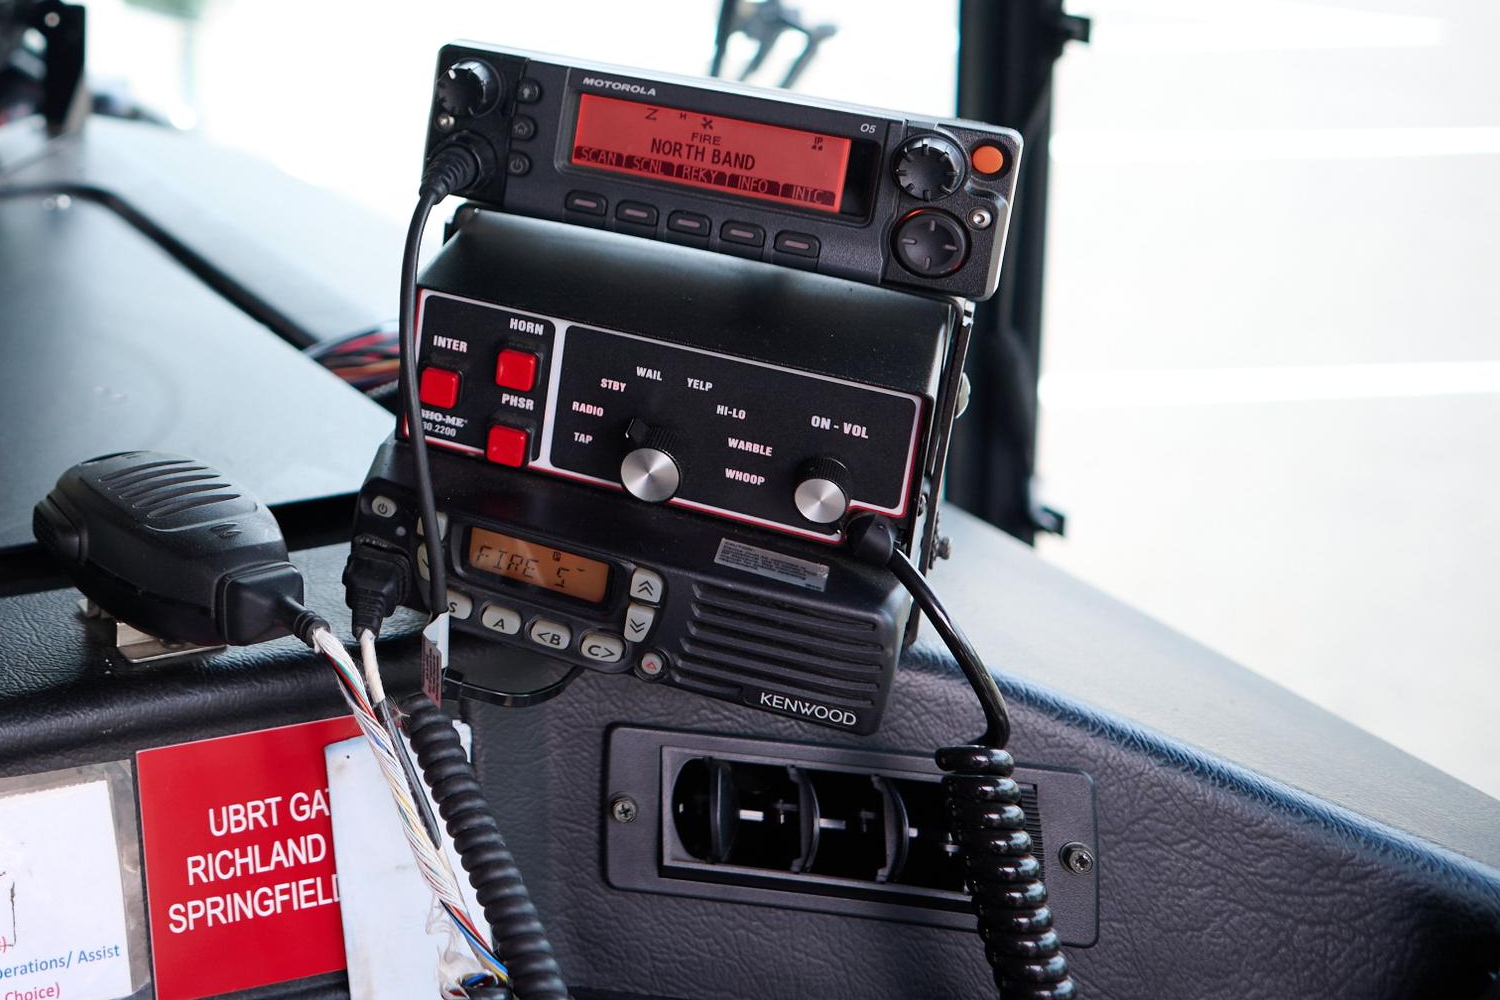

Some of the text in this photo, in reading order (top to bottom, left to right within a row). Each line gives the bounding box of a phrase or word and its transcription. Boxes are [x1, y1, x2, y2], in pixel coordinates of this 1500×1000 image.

[583, 77, 656, 96] MOTOROLA
[691, 132, 722, 146] FIRE
[651, 137, 756, 171] NORTH BAND
[581, 147, 617, 165] SCAN
[683, 167, 718, 183] REKY
[738, 175, 769, 193] INFO
[510, 318, 544, 335] HORN
[433, 335, 468, 352] INTER
[636, 366, 663, 381] WAIL
[600, 378, 627, 392] STBY
[686, 378, 713, 392] YELP
[501, 393, 535, 411] PHSR
[572, 401, 604, 417] RADIO
[716, 404, 746, 420] HI-LO
[811, 415, 831, 430] ON
[843, 422, 869, 439] VOL
[573, 432, 593, 444] TAP
[728, 437, 773, 457] WARBLE
[725, 468, 766, 486] WHOOP
[475, 545, 539, 580] FIRE
[449, 601, 458, 613] S
[493, 618, 505, 631] A
[760, 692, 857, 726] KENWOOD
[208, 788, 331, 837] UBRT GA
[186, 833, 327, 886] RICHLAND
[77, 943, 120, 964] Assist
